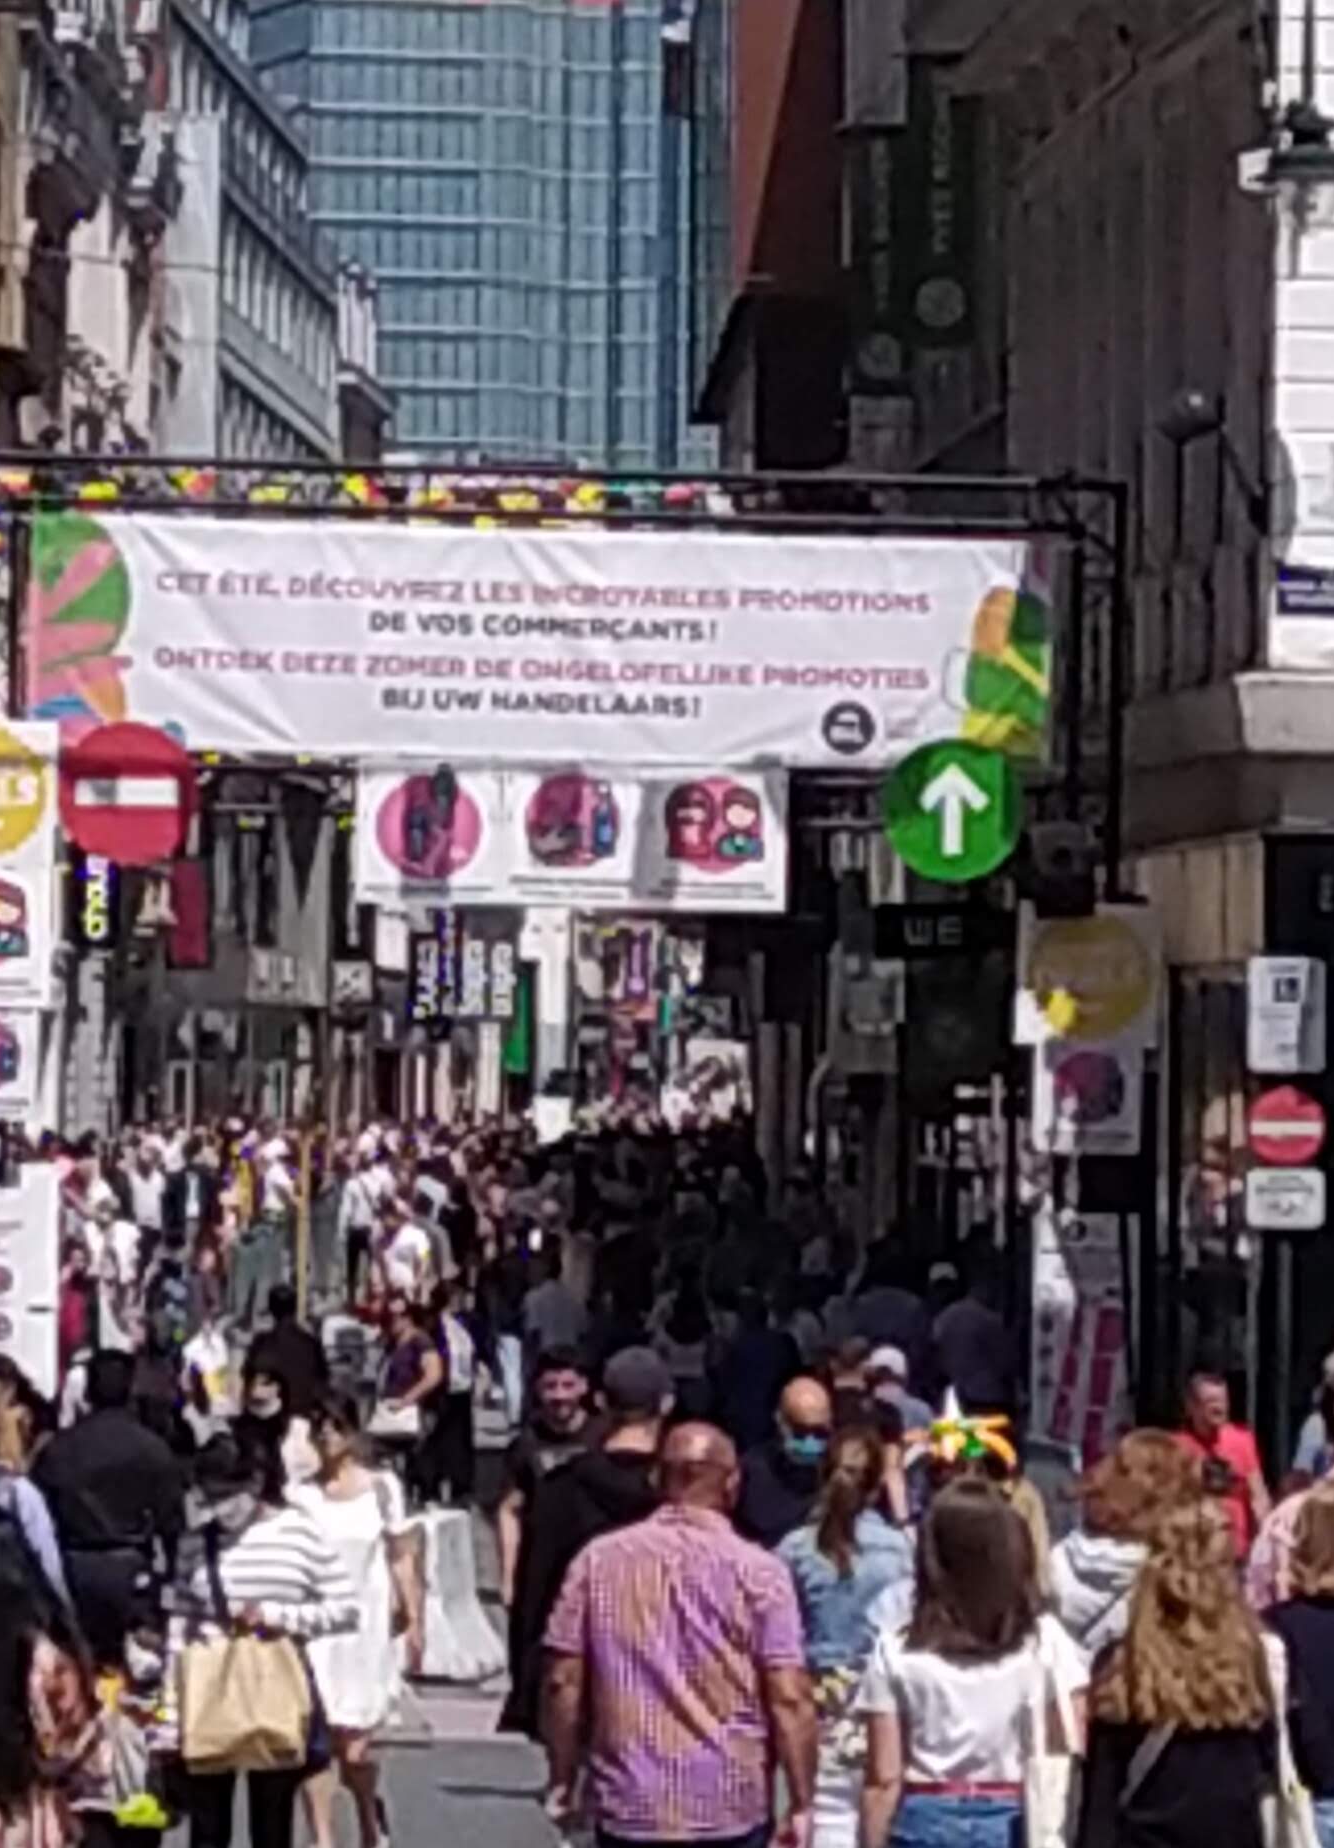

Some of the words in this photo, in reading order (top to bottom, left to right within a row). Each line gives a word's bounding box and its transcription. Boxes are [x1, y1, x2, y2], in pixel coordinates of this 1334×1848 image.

[157, 572, 210, 595] CET
[288, 572, 464, 602] DÉCOUVREZ
[473, 581, 525, 604] LES
[533, 582, 731, 612] INCROYABLES
[740, 588, 930, 614] PROMOTIONS
[370, 610, 406, 633] DE
[417, 613, 473, 637] VOS
[153, 646, 274, 673] ONTDEK
[282, 651, 357, 675] DEZE
[365, 655, 466, 679] ZOMER
[475, 658, 512, 679] DE
[520, 659, 755, 687] ONGELOFELIJKE
[763, 664, 930, 690] PROMOTIES
[382, 688, 425, 712] BIJ
[433, 689, 483, 712] UW
[903, 914, 964, 948] WE
